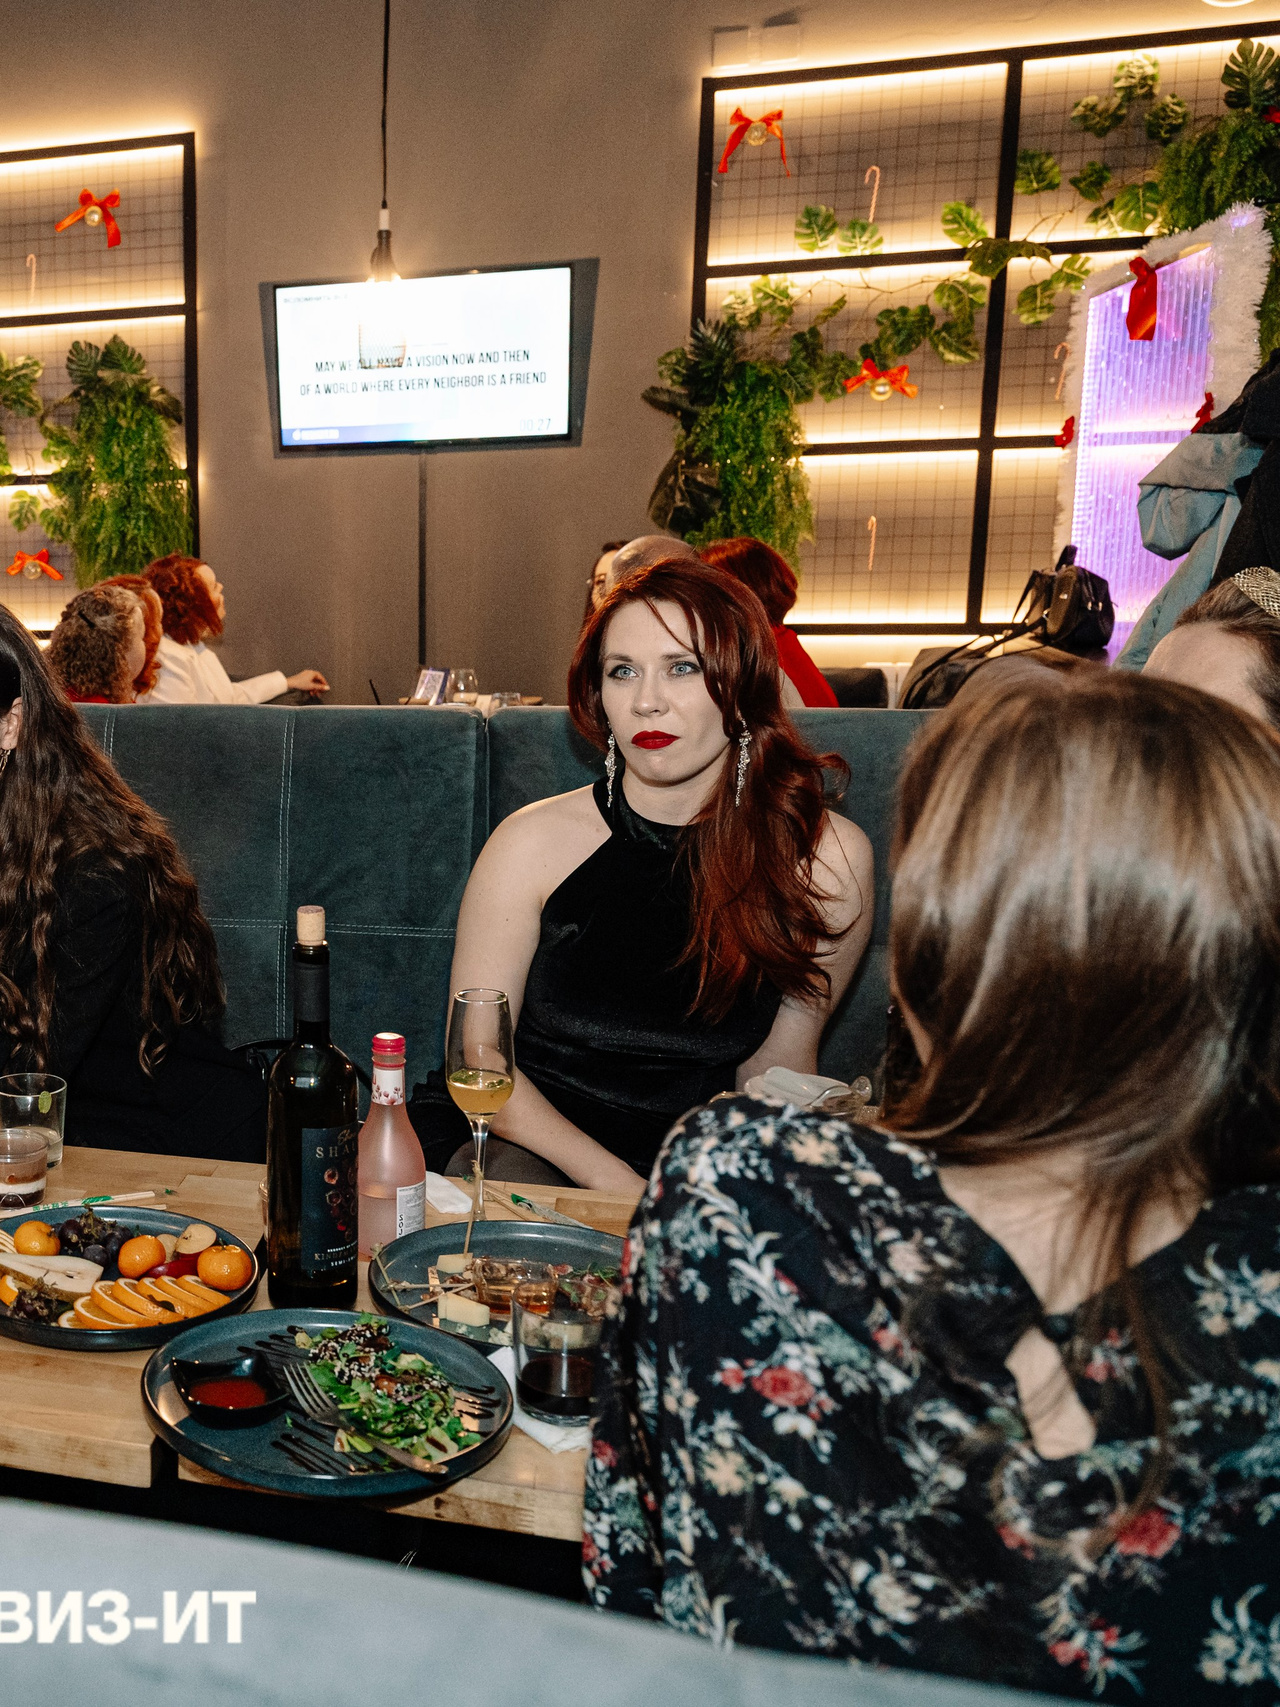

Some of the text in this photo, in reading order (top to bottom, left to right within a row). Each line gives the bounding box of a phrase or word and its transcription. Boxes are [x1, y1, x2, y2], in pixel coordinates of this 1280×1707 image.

[315, 361, 335, 372] MAY
[339, 360, 353, 371] WE
[406, 357, 412, 368] A
[416, 355, 449, 367] VISION
[452, 353, 475, 365] NOW
[479, 351, 500, 363] AND
[504, 350, 530, 362] THEN
[300, 371, 547, 396] OF A WORLD WHERE EVERY NEIGHBOR IS A FRIEND
